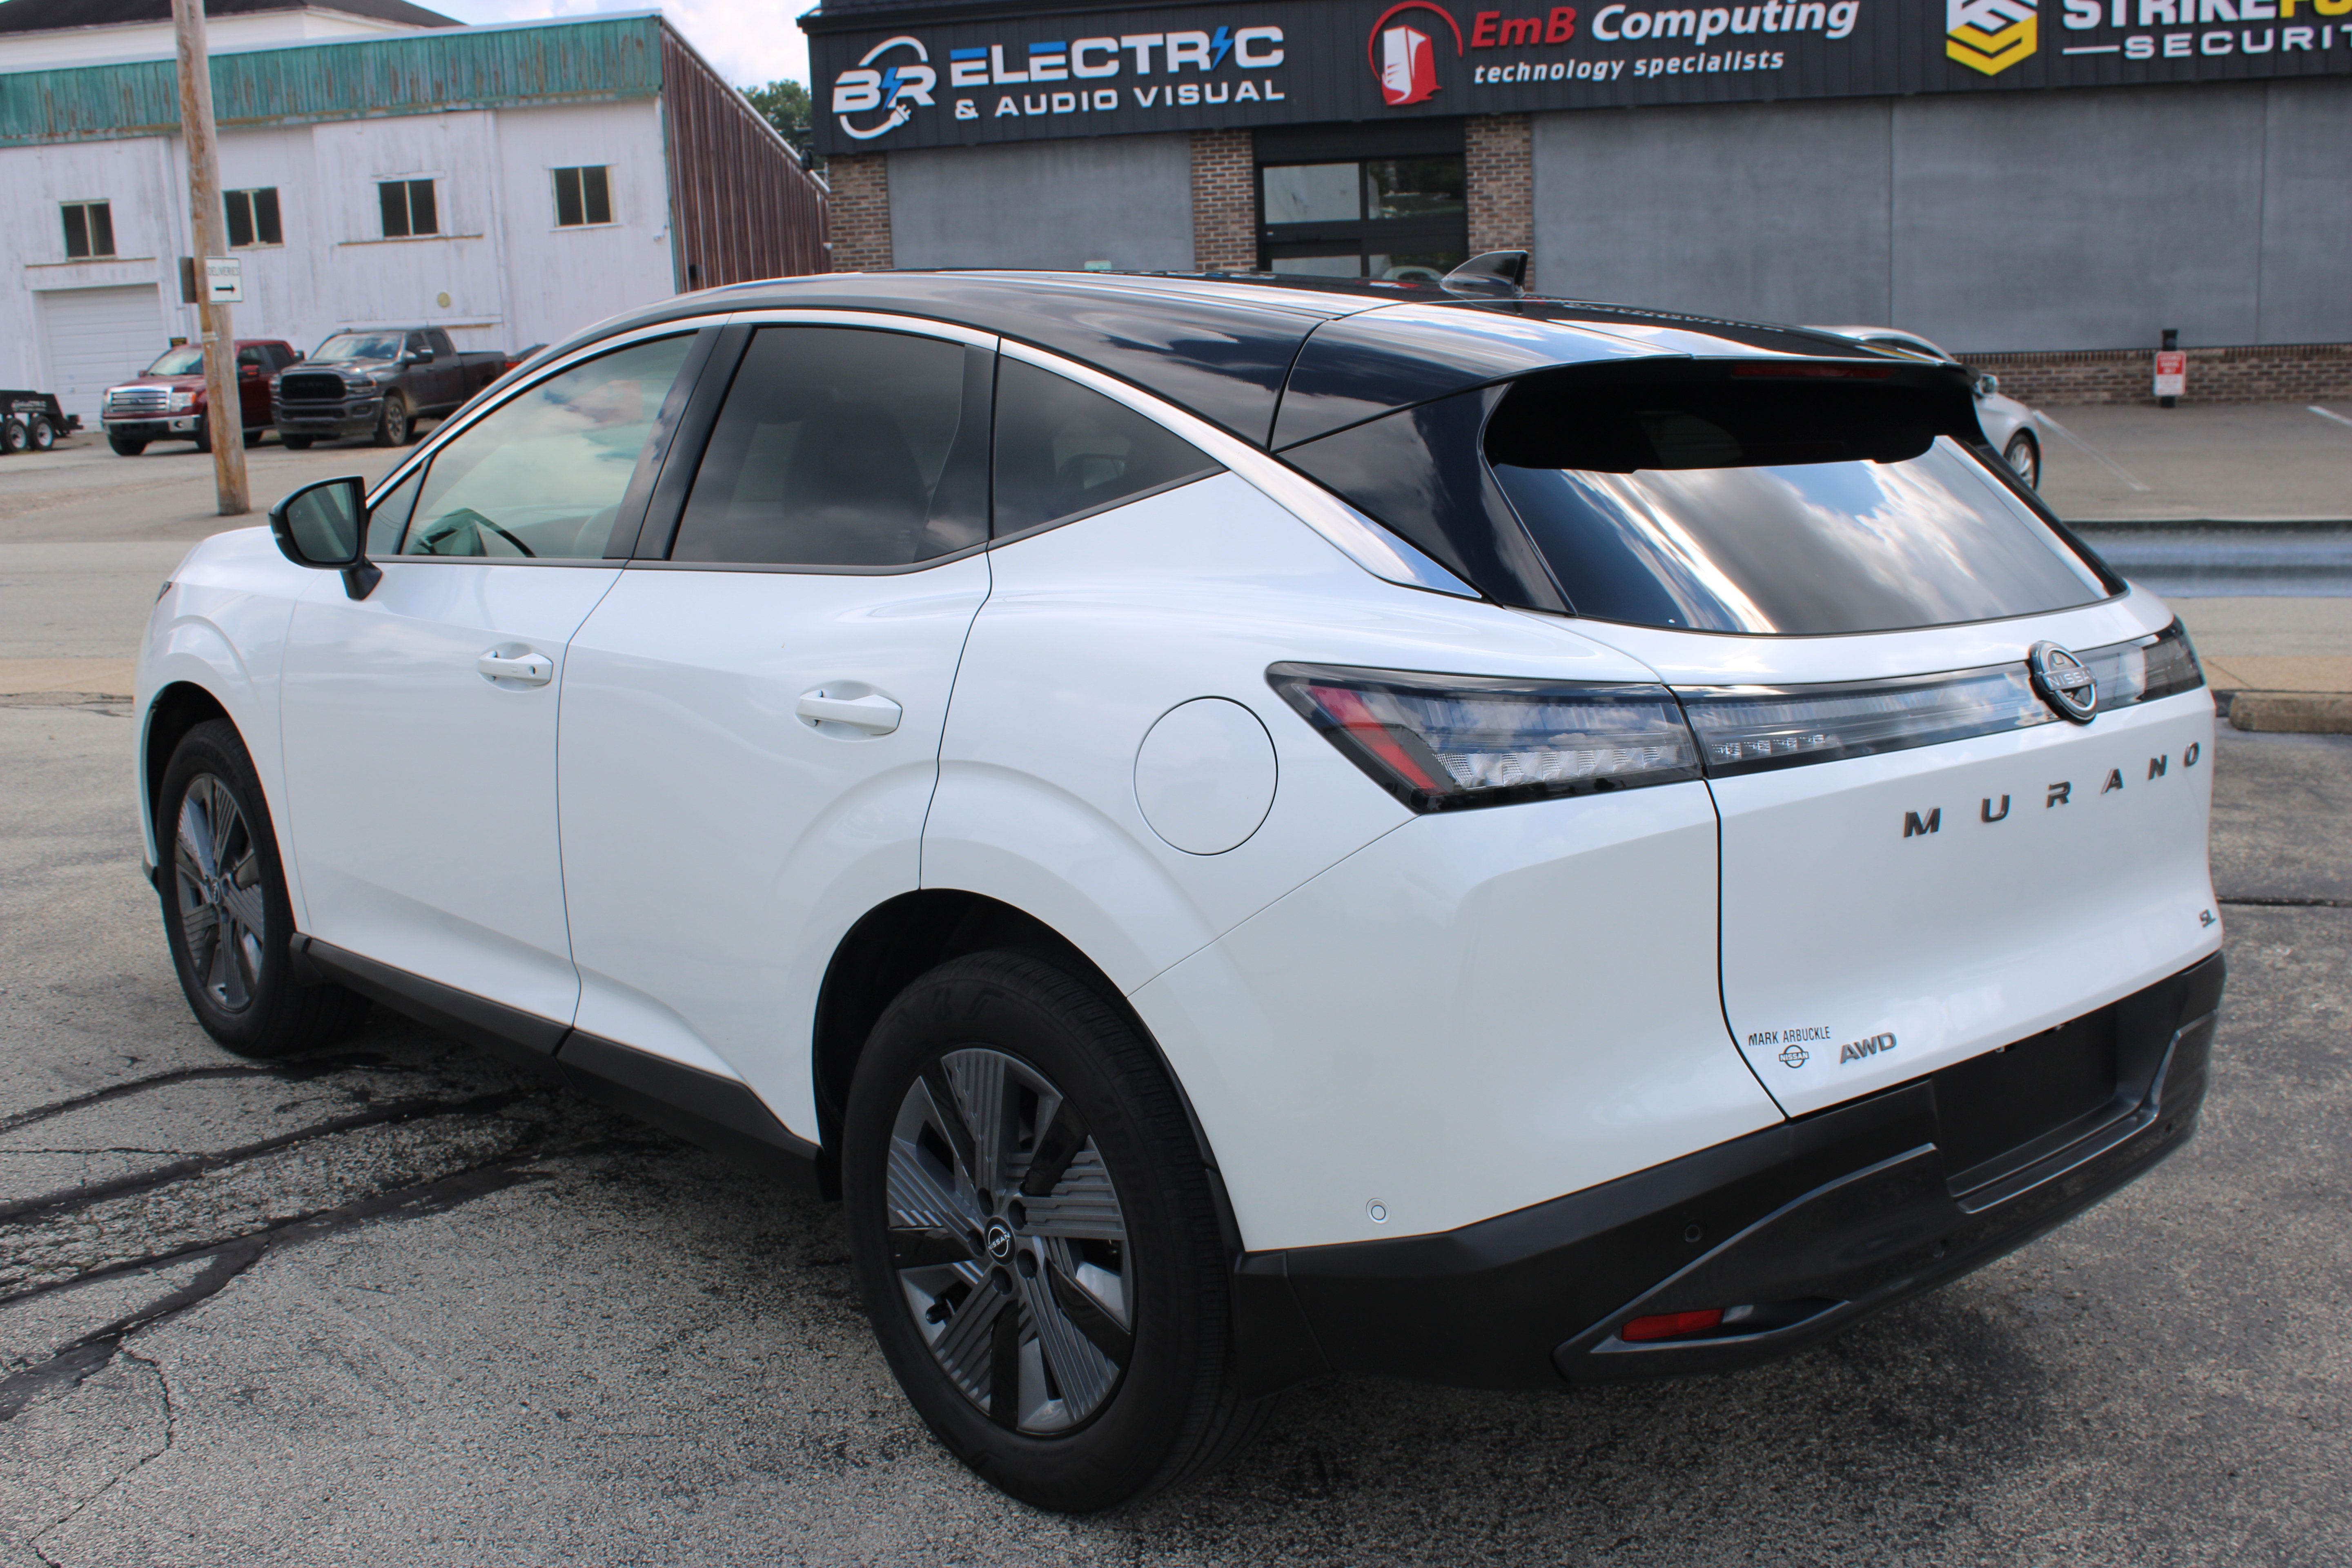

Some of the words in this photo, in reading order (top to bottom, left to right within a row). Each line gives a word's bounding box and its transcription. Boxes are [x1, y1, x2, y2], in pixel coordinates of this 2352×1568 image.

[1471, 6, 1577, 47] EmB
[1591, 0, 1860, 46] Computing
[1474, 58, 1626, 84] technology
[1633, 50, 1784, 78] specialists
[955, 98, 979, 120] &
[994, 89, 1118, 118] AUDIO
[1133, 79, 1285, 108] VISUAL
[1903, 742, 2200, 838] MURANO
[1748, 1030, 1780, 1046] MARK
[1782, 1026, 1831, 1043] ARBUCKLE
[1840, 1031, 1897, 1064] AWD
[1779, 1051, 1809, 1062] NISSAN
[988, 1232, 1010, 1250] NISSAN
